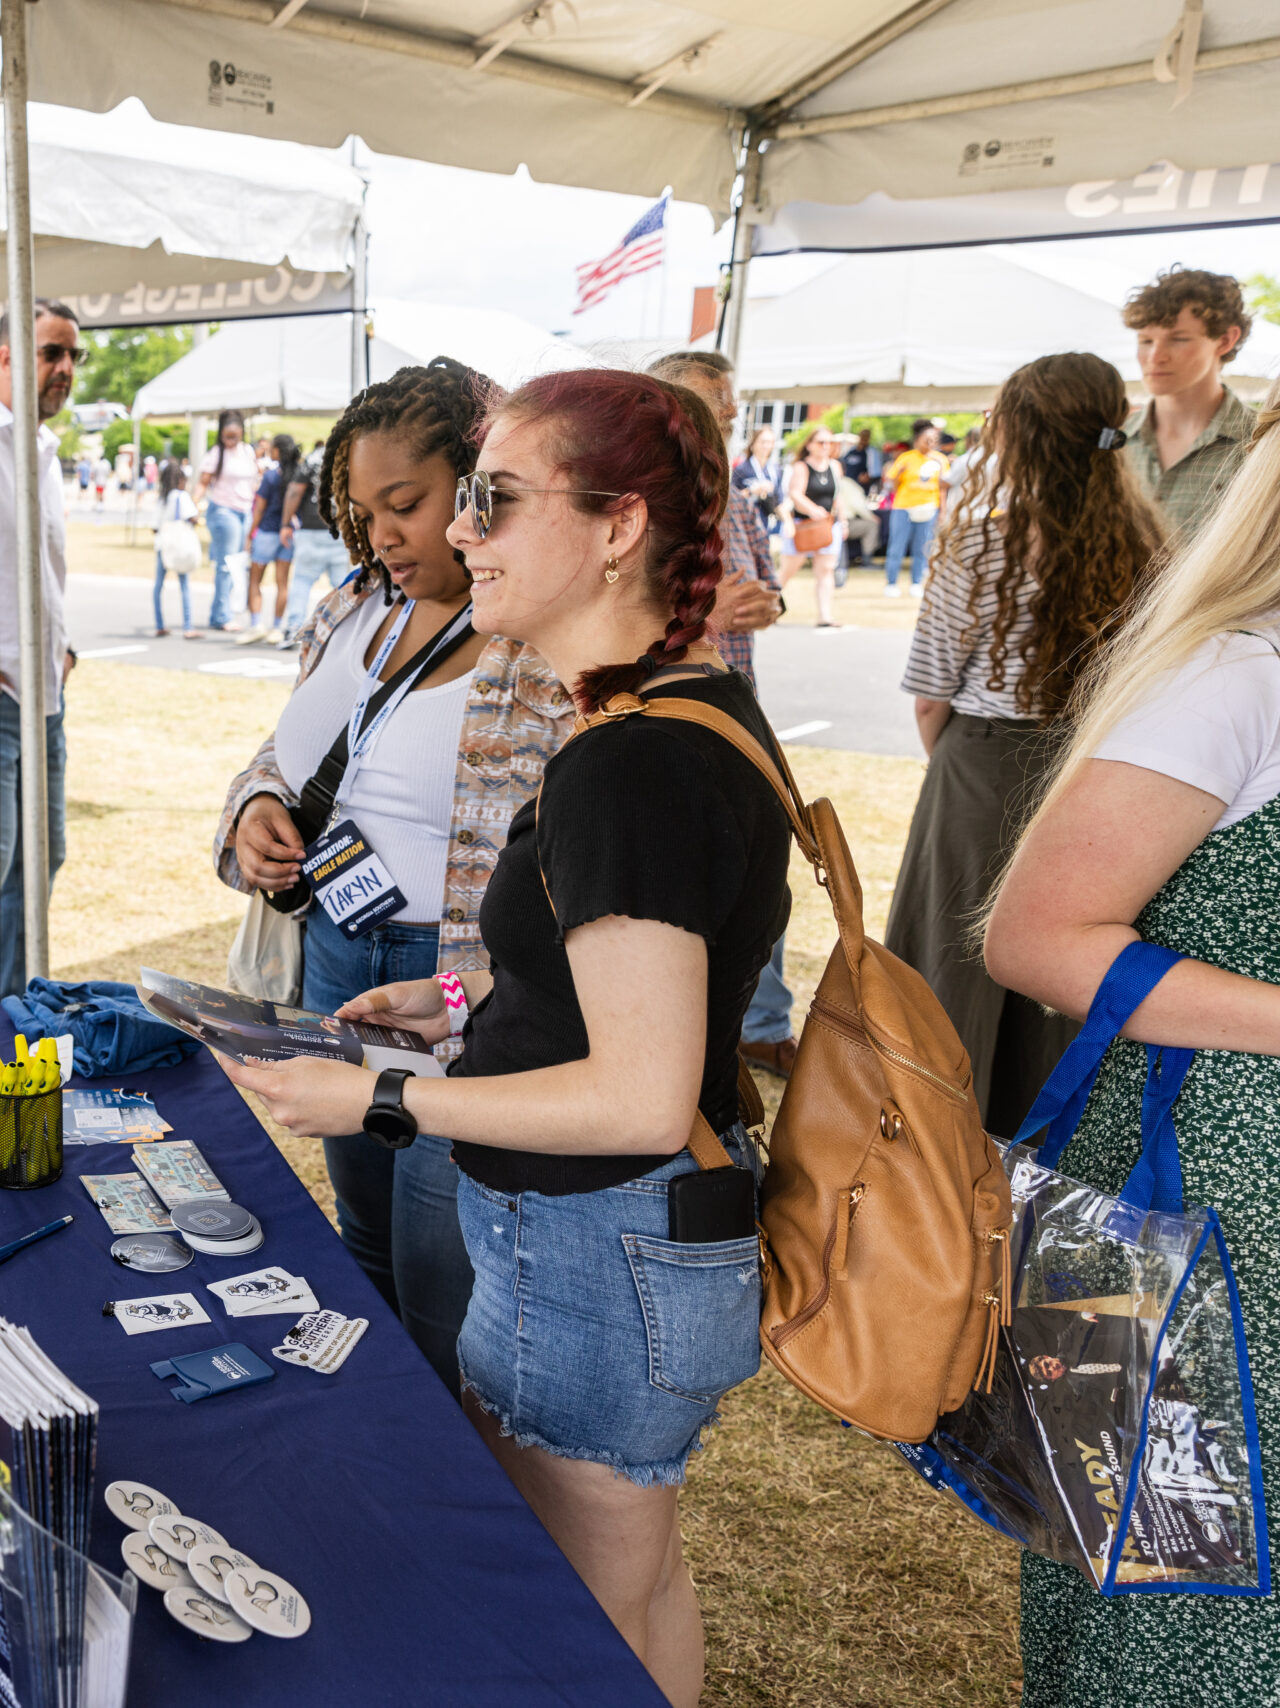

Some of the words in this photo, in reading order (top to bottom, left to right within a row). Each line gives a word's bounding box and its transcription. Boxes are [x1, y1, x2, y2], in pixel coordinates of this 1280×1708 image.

[302, 834, 353, 875] DESTINATION:
[313, 858, 337, 882] EAGLE
[335, 839, 365, 868] NATION
[321, 866, 382, 917] TARYN
[299, 1312, 334, 1350] SOUTHERN
[1100, 1430, 1122, 1473] SOUND
[1130, 1509, 1147, 1538] FIND
[1151, 1512, 1164, 1537] MUSIC
[1177, 1510, 1191, 1535] MUSIC
[1141, 1540, 1155, 1558] TO
